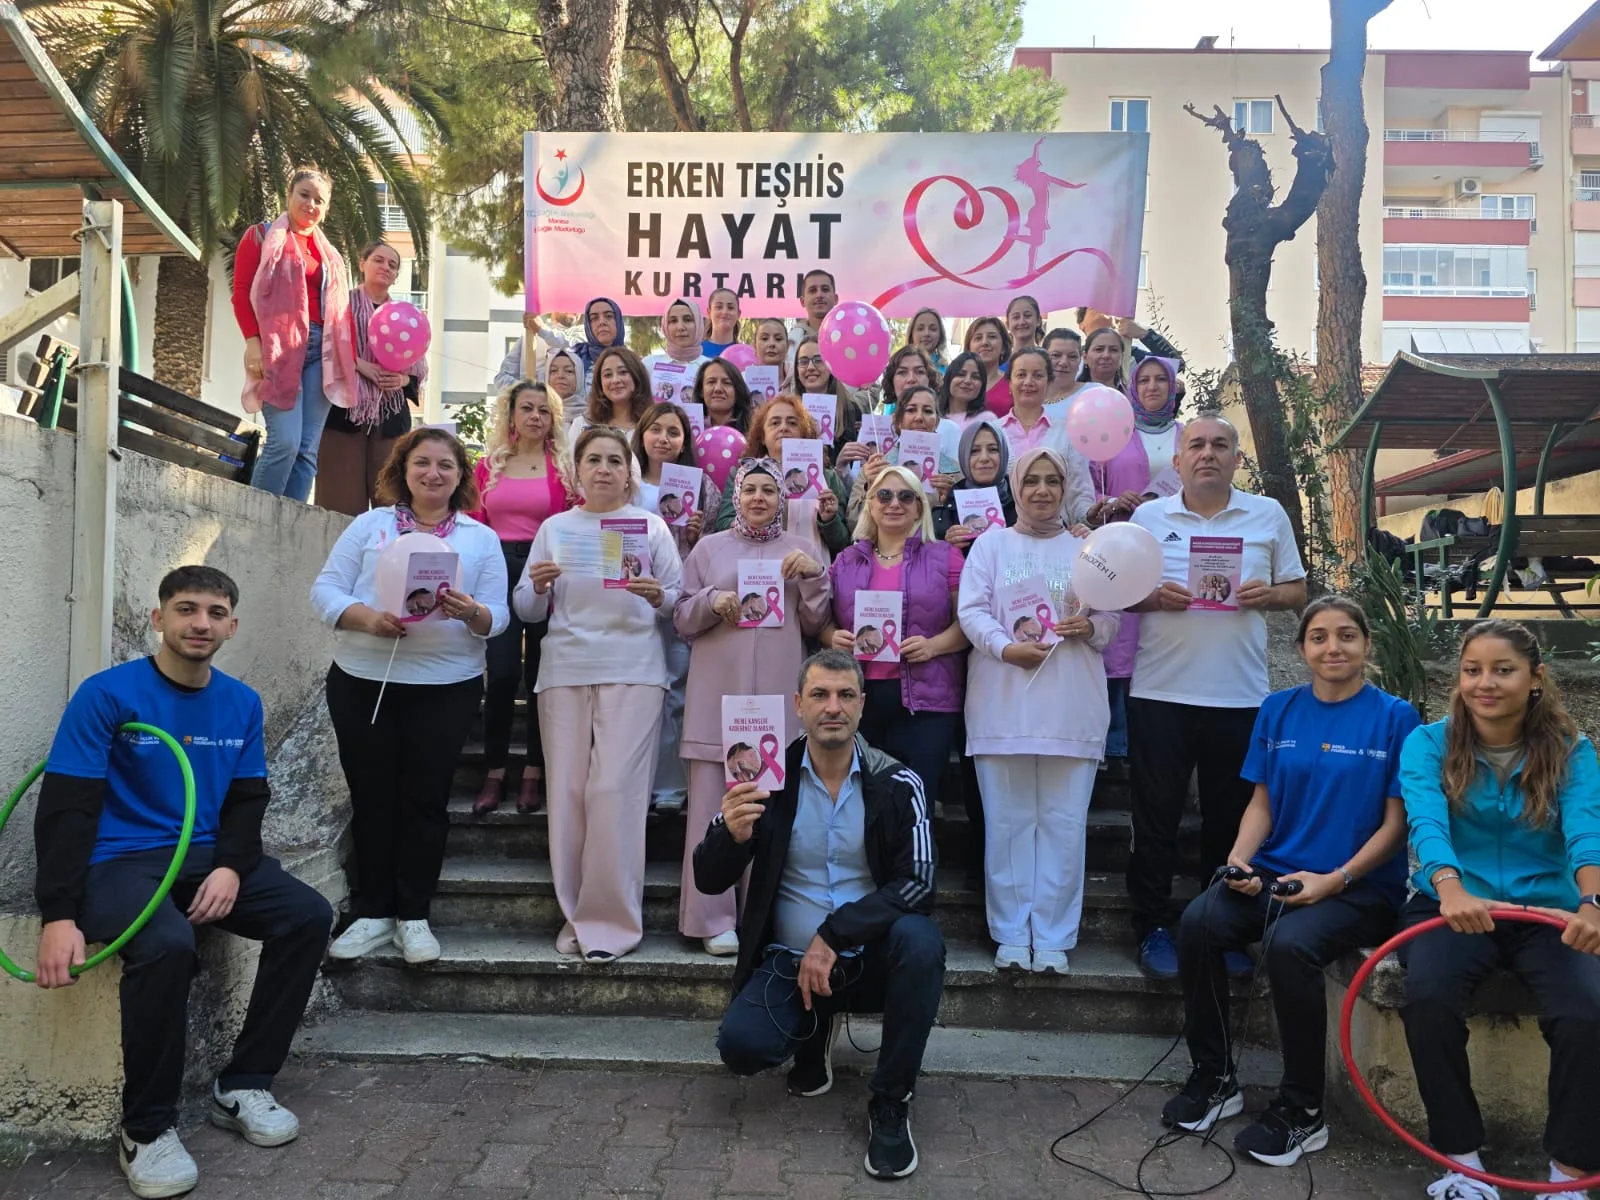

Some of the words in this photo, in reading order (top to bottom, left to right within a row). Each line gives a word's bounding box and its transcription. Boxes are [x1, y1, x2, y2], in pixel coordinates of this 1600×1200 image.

[626, 161, 725, 198] ERKEN
[736, 153, 845, 207] TEŞHİS
[627, 212, 842, 260] HAYAT
[624, 270, 804, 299] KURTARI
[1079, 551, 1109, 574] FROZEN
